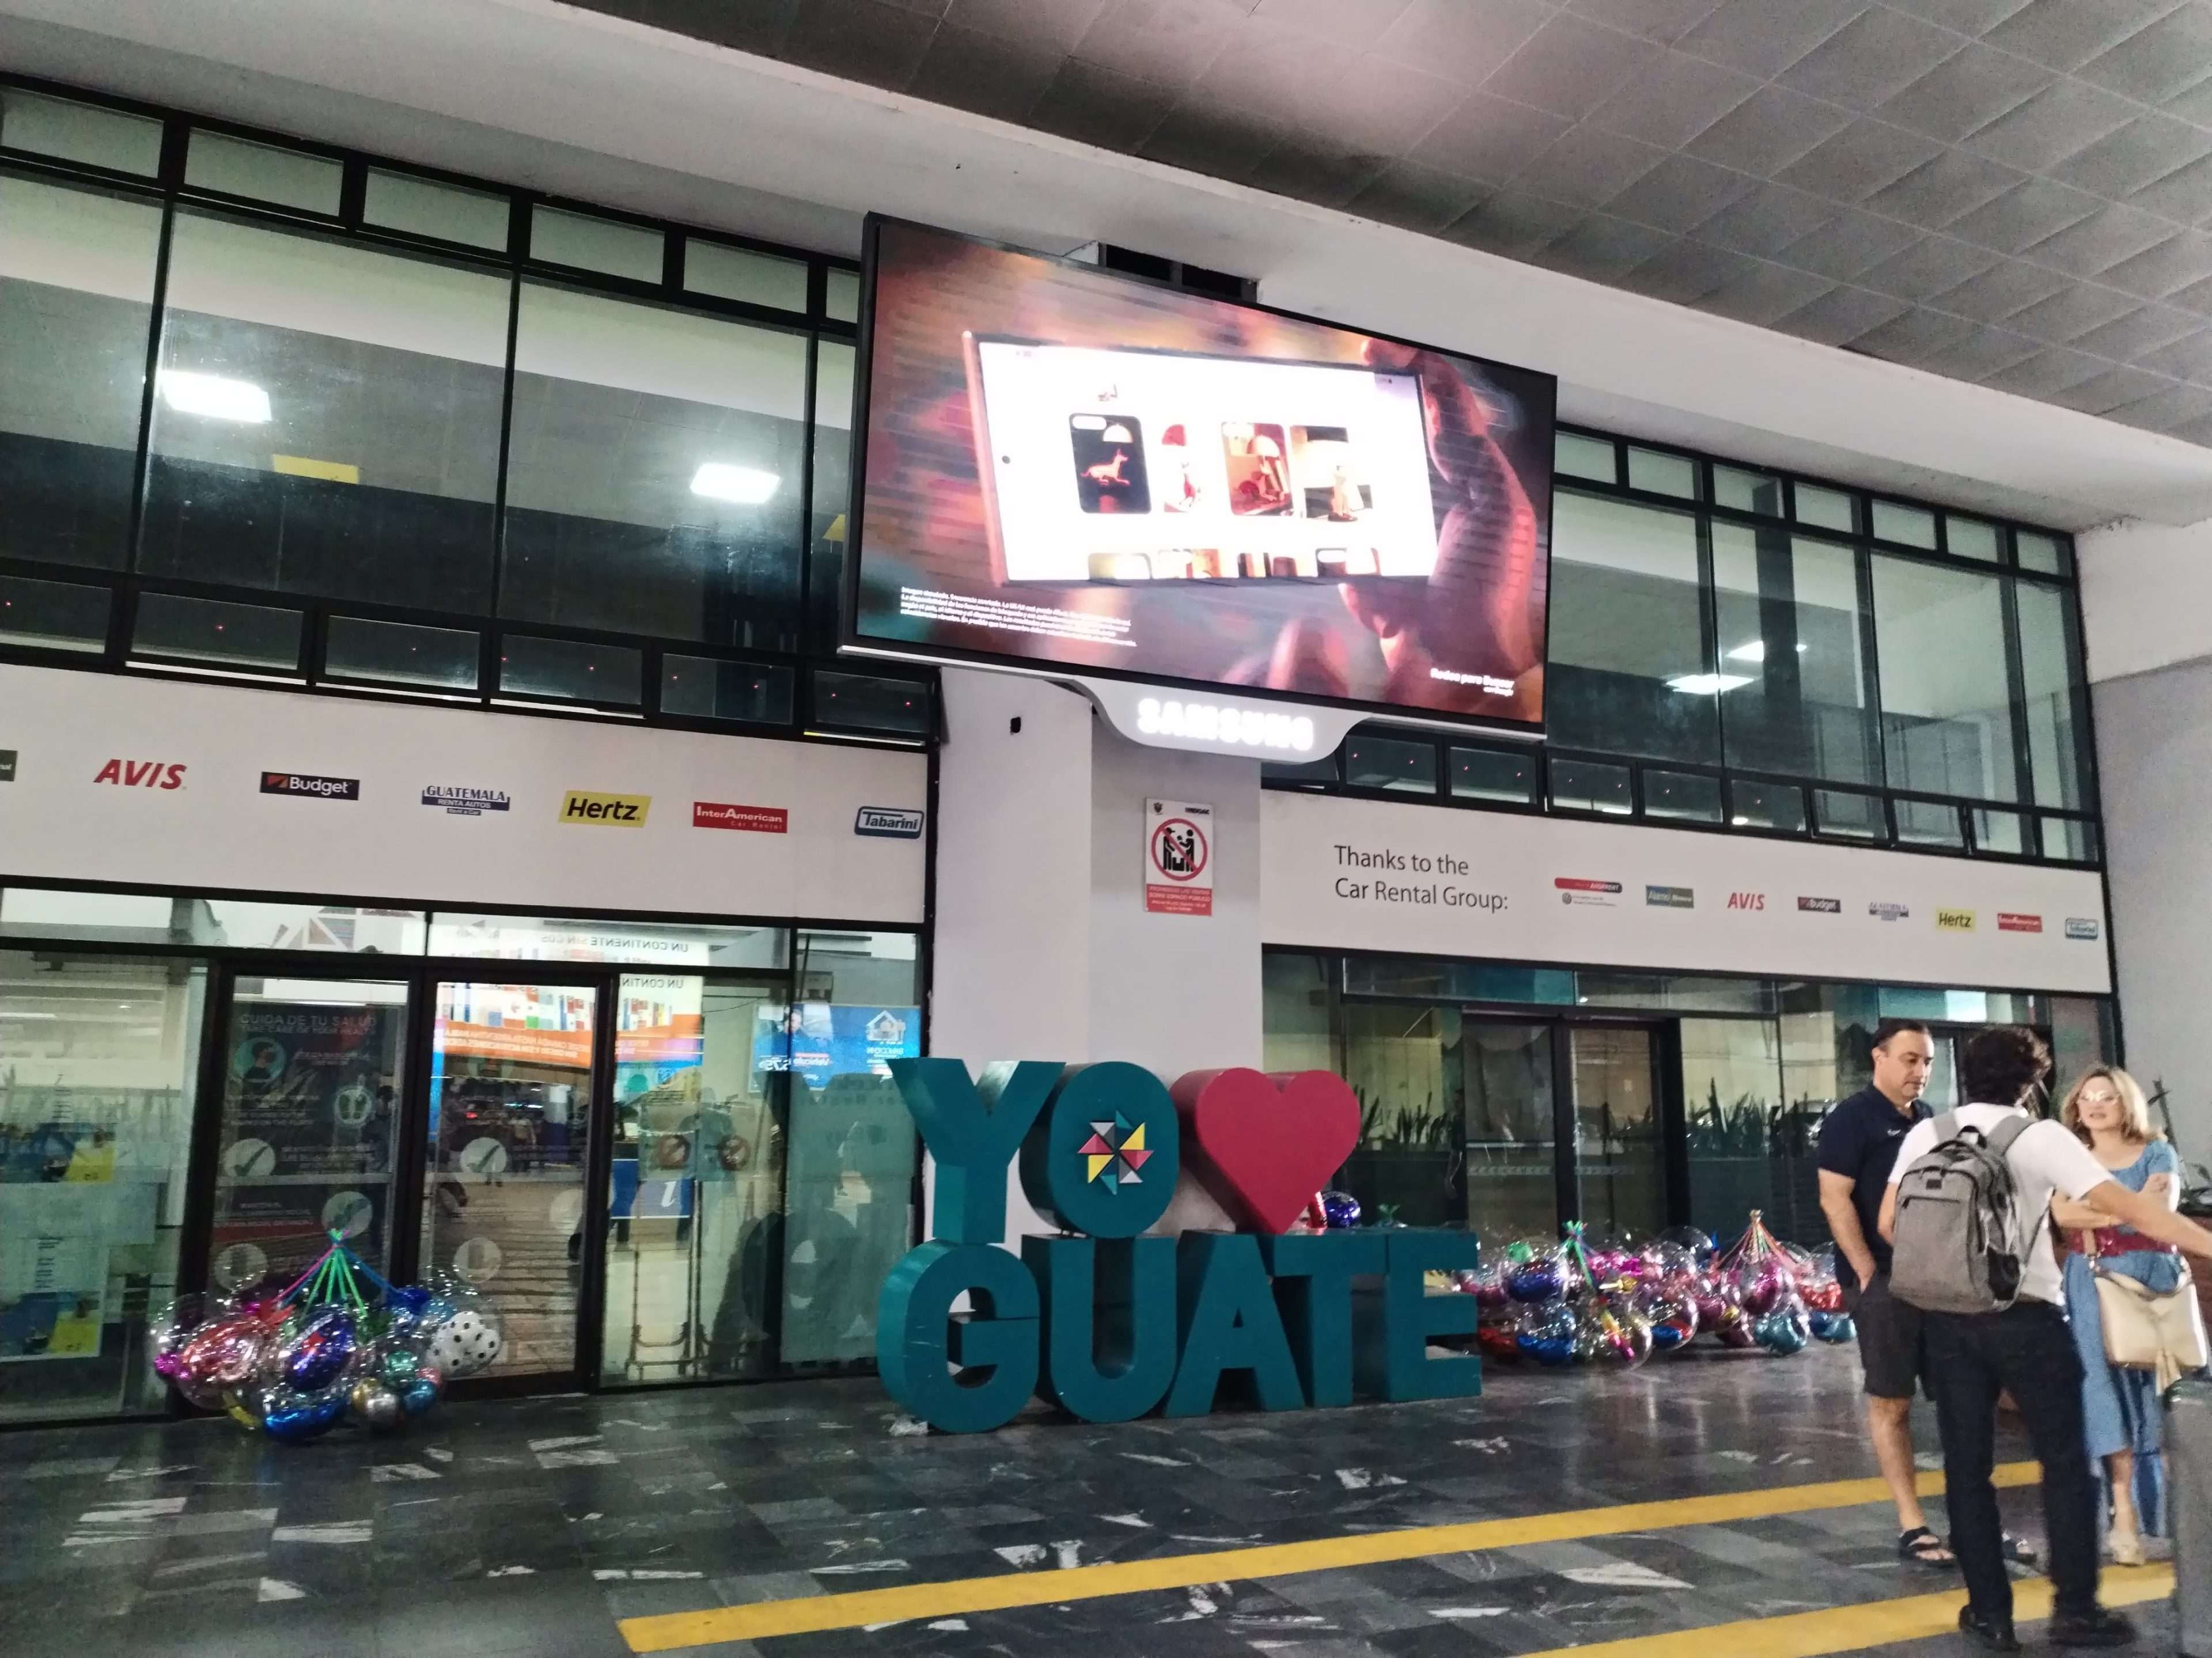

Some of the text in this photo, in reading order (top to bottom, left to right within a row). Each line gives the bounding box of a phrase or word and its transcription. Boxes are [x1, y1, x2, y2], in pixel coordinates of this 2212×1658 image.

[93, 758, 188, 790] AVIS
[289, 776, 349, 796] Budget
[426, 785, 505, 802] GUATEMALA
[437, 799, 491, 809] RENTA AUTOS
[566, 797, 639, 821] Hertz
[696, 806, 784, 822] InterAmerican
[862, 811, 919, 830] Tabarini
[1334, 845, 1469, 875] Thanks to the
[1335, 877, 1509, 914] Car Rental Group:
[1727, 892, 1766, 910] AVIS
[1938, 912, 1971, 928] Hertz
[240, 1014, 285, 1024] CUIDA
[286, 1014, 306, 1025] DE
[309, 1015, 327, 1026] TU
[884, 1057, 1180, 1244] YO
[876, 1229, 1483, 1435] GUATE
